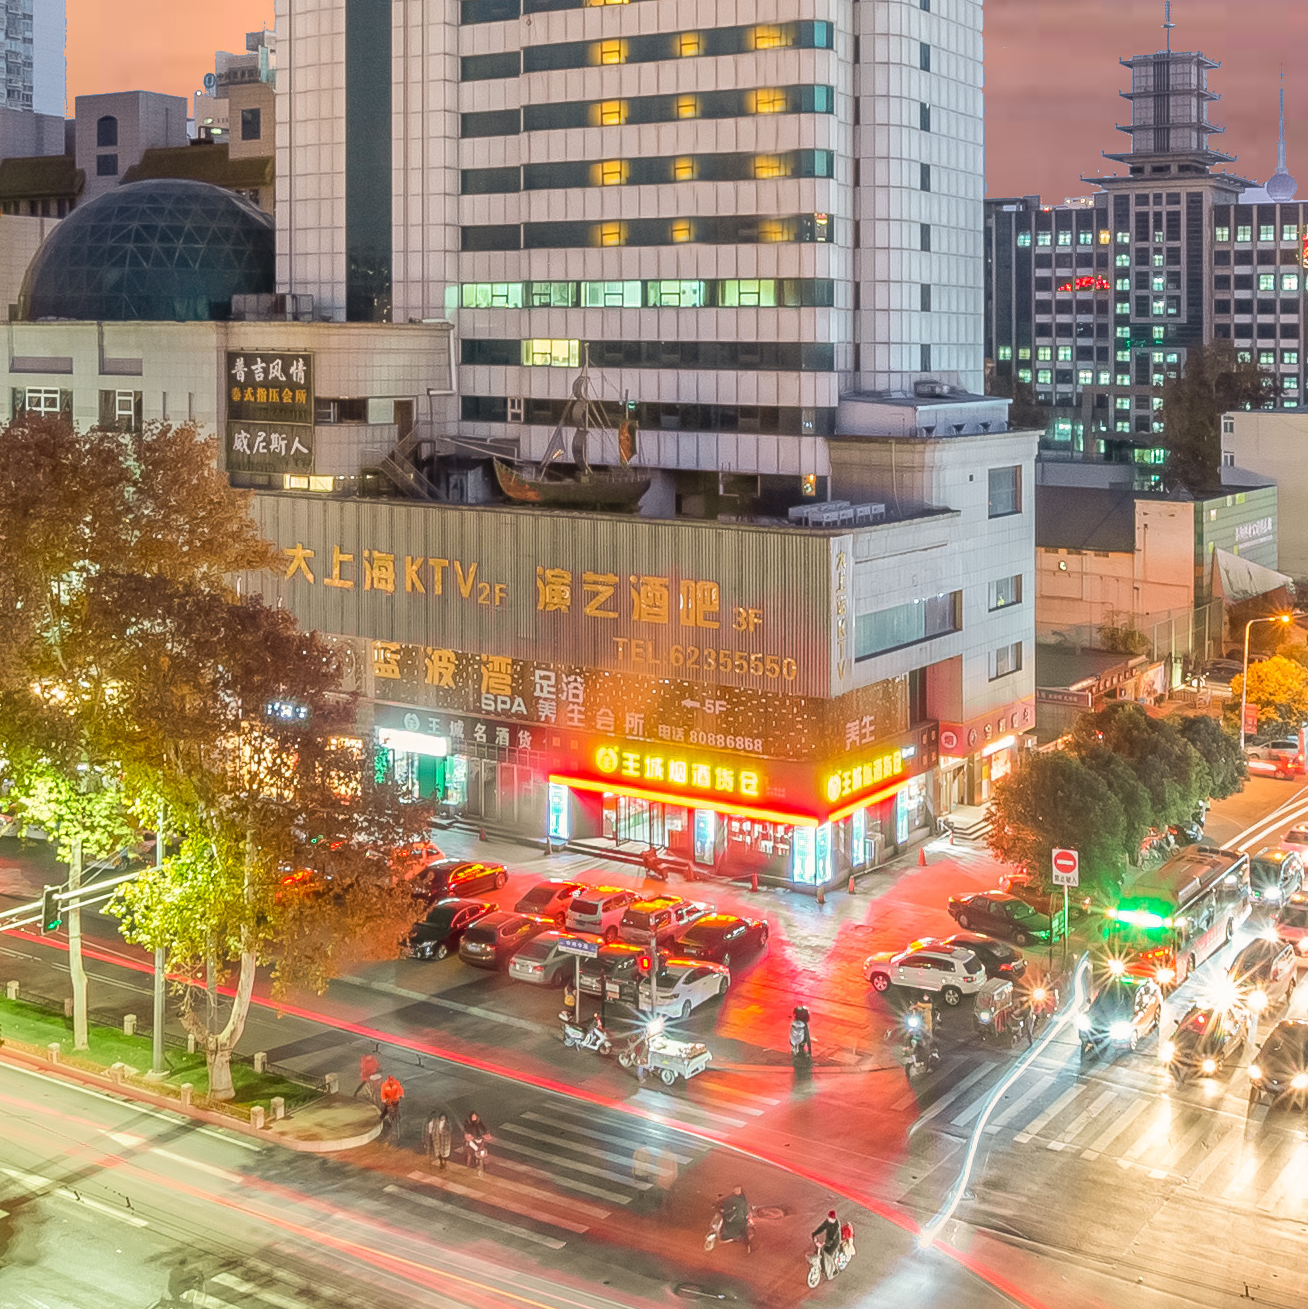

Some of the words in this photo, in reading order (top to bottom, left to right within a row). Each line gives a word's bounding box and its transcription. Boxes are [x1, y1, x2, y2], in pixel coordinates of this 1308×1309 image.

[231, 356, 307, 385] 普吉风情
[231, 386, 307, 404] 泰式指压会所
[232, 429, 309, 456] 威尼斯人
[284, 543, 478, 599] 大上海KTV
[477, 582, 509, 607] 2F
[536, 566, 720, 629] 演艺酒吧
[732, 606, 764, 633] 3F
[372, 640, 513, 696] 蓝波湾
[534, 668, 585, 704] 足浴
[481, 694, 528, 715] SPA
[538, 698, 645, 737] 养生会所
[702, 698, 728, 715] 5F
[427, 717, 533, 750] 王城名酒货
[657, 724, 685, 742] 电话
[689, 729, 764, 753] 80886868
[845, 715, 876, 752] 养生
[621, 752, 759, 797] 王城烟酒货仓
